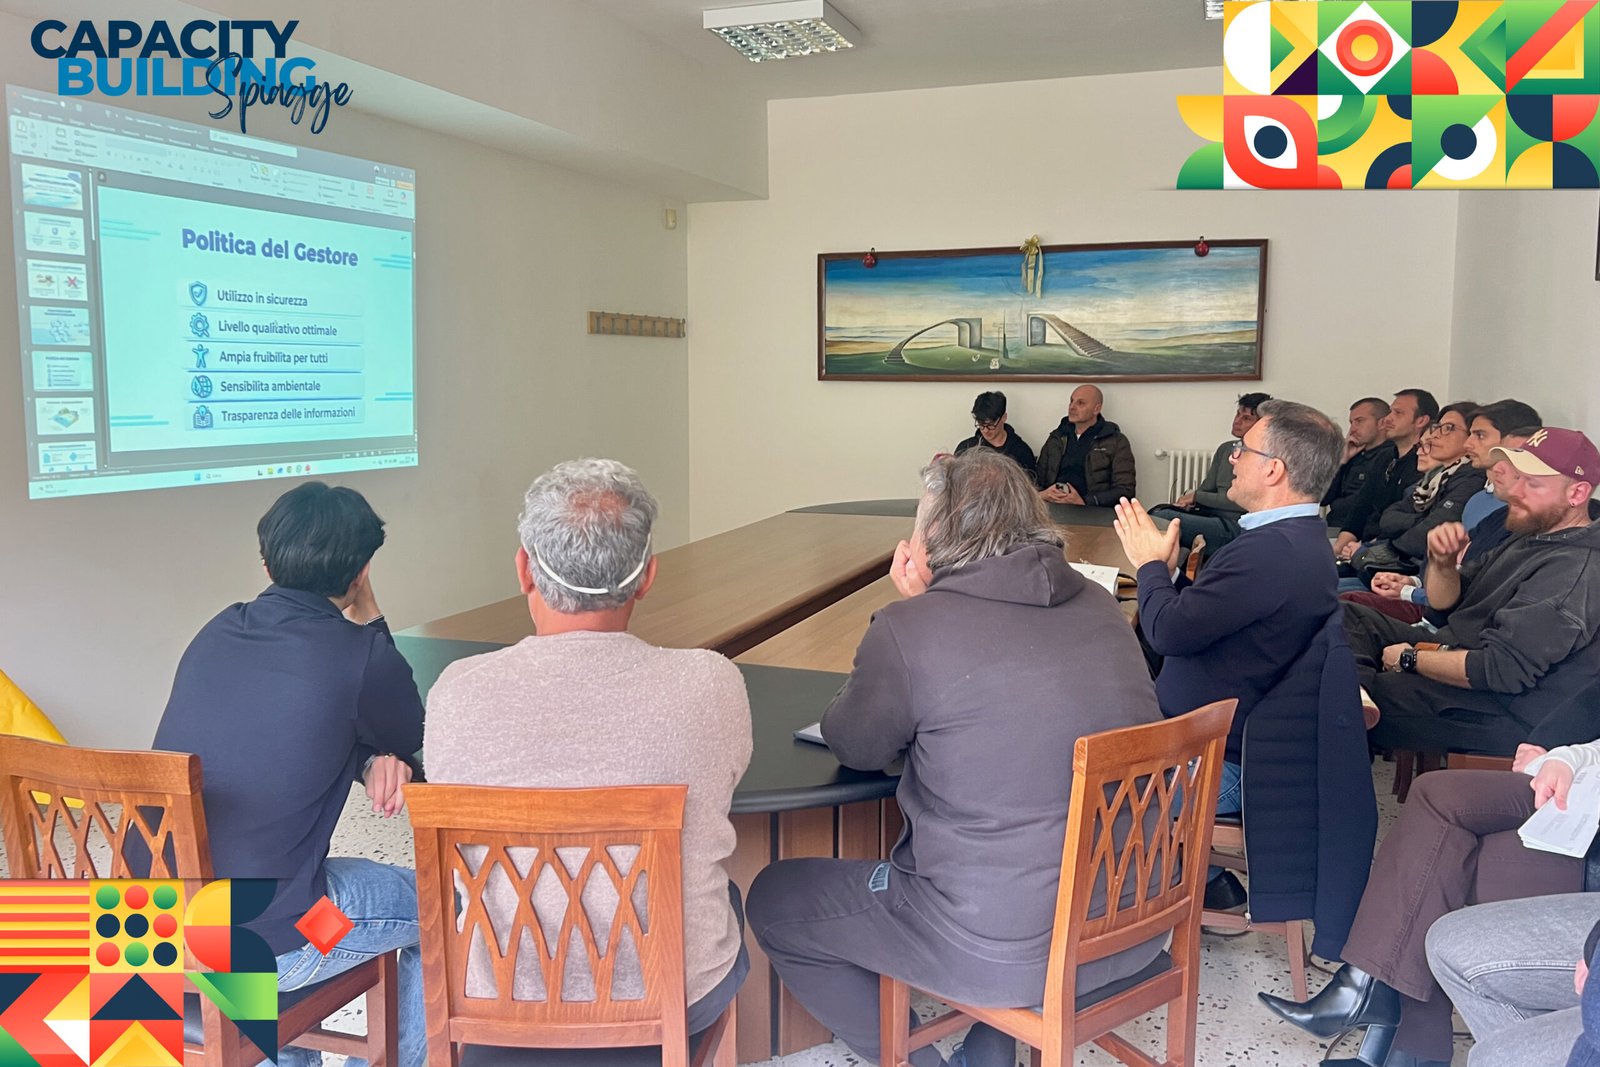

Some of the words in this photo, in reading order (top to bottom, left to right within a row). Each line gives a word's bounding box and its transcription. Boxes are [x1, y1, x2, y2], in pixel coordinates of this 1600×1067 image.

[182, 228, 256, 256] Politica
[261, 238, 289, 259] del
[294, 242, 359, 267] Gestore
[217, 290, 254, 303] Utilizzo
[255, 291, 265, 304] in
[266, 293, 308, 306] sicurezza
[218, 320, 250, 333] Livello
[252, 320, 300, 335] qualitativo
[301, 323, 337, 336] ottimale
[219, 351, 251, 365] Ampia
[293, 353, 309, 366] per
[310, 352, 328, 364] tutti
[271, 380, 321, 392] ambientale
[221, 410, 279, 424] Trasparenza
[280, 408, 302, 420] delle
[304, 406, 356, 419] informazioni
[1526, 428, 1548, 447] NY
